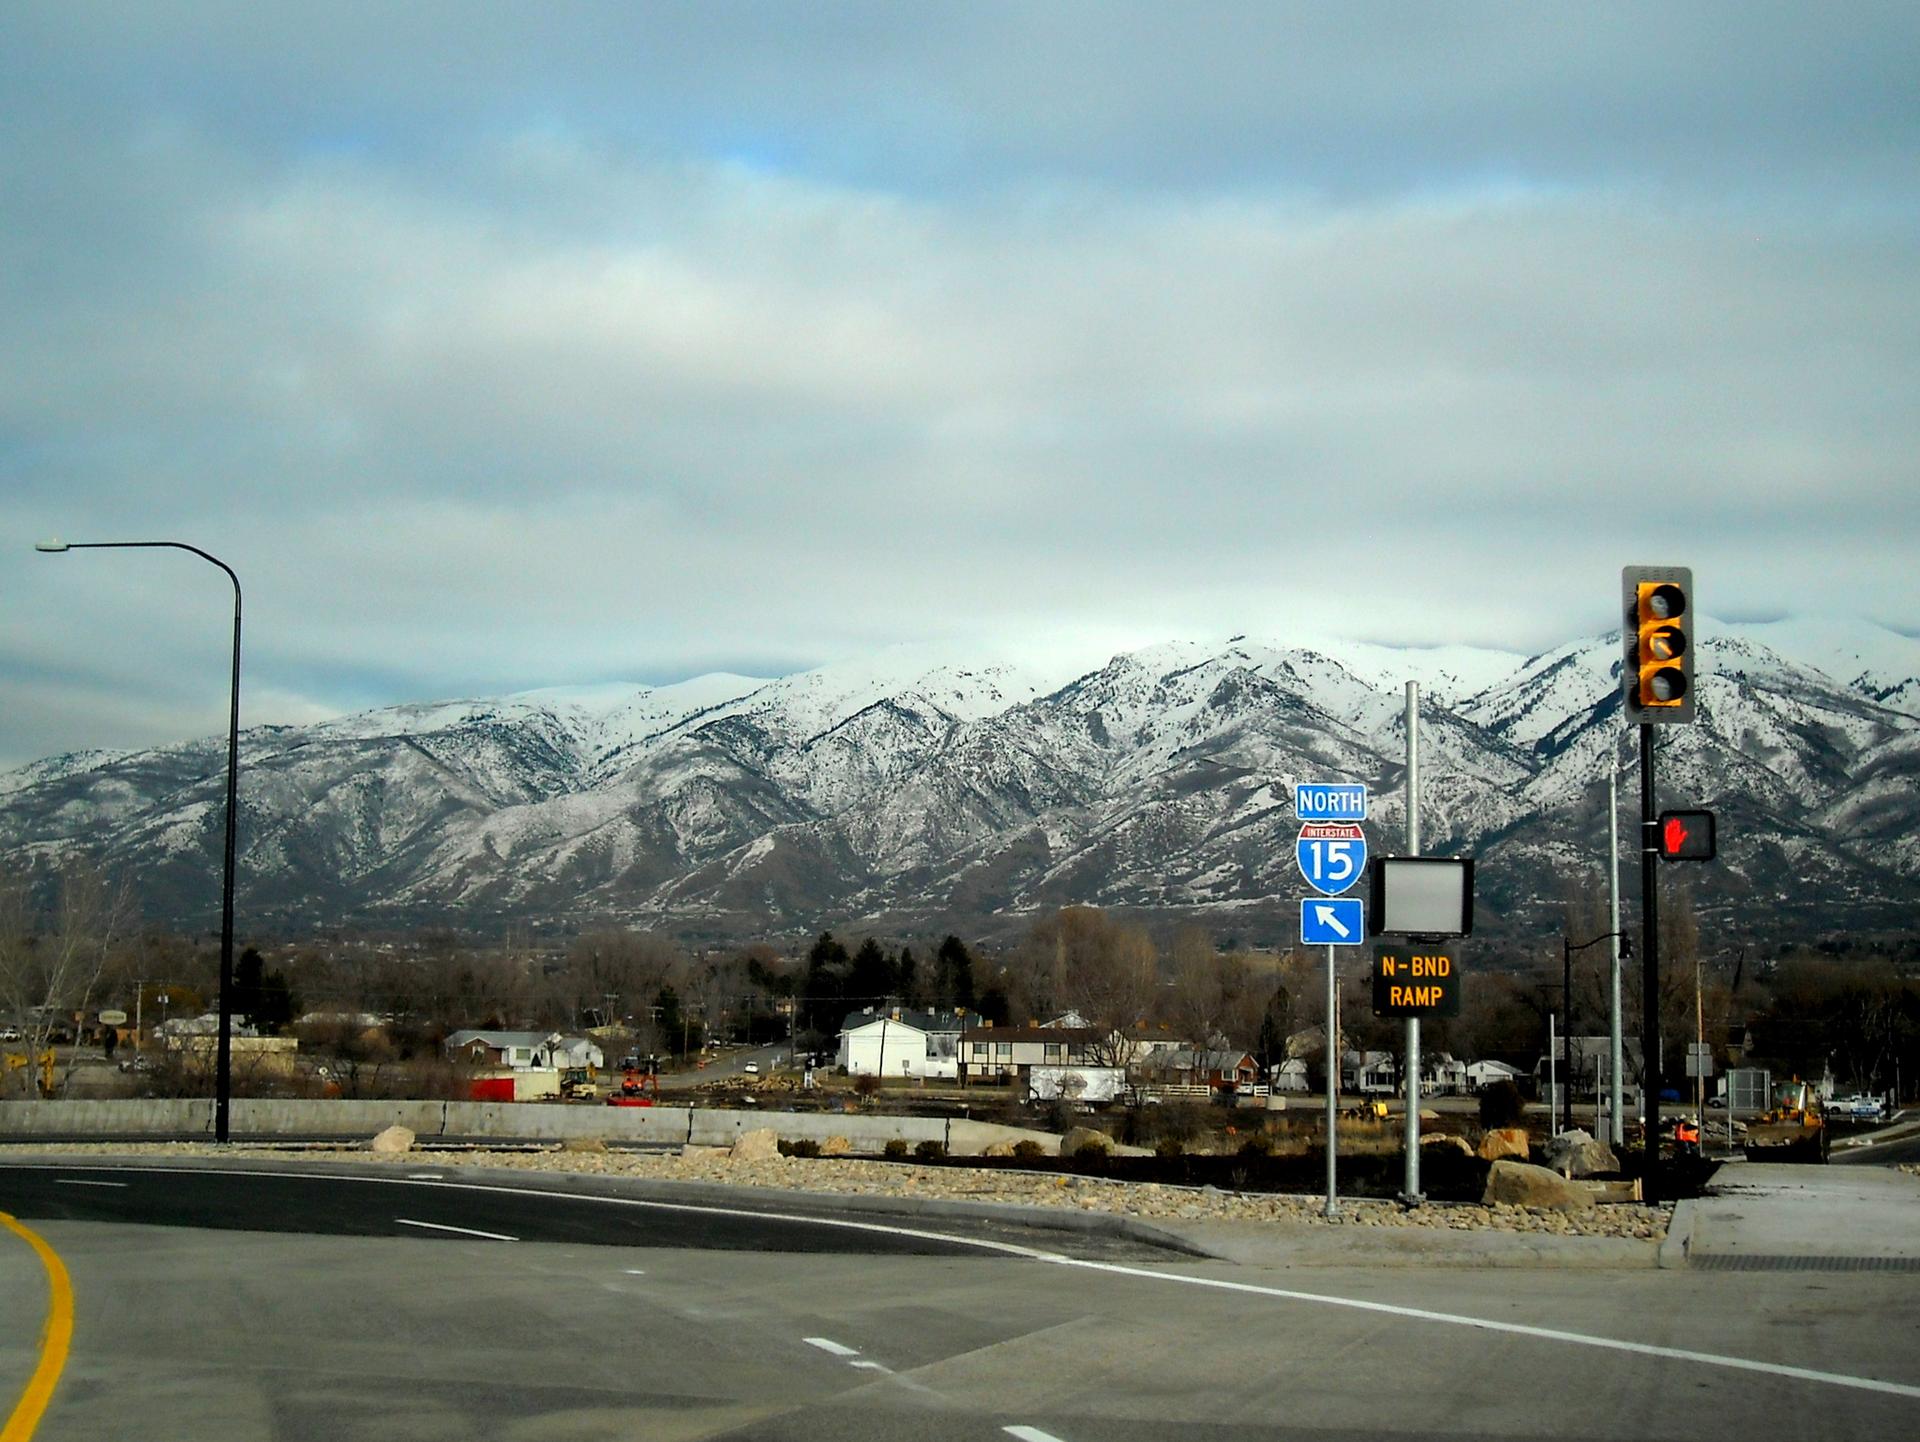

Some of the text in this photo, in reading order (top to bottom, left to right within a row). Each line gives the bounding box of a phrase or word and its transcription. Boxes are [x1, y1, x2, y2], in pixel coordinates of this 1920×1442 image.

[1300, 791, 1362, 812] NORTH
[1307, 828, 1354, 838] INTERSTATE
[1310, 841, 1353, 880] 15
[1383, 956, 1450, 977] N-BND
[1390, 986, 1443, 1007] RAMP
